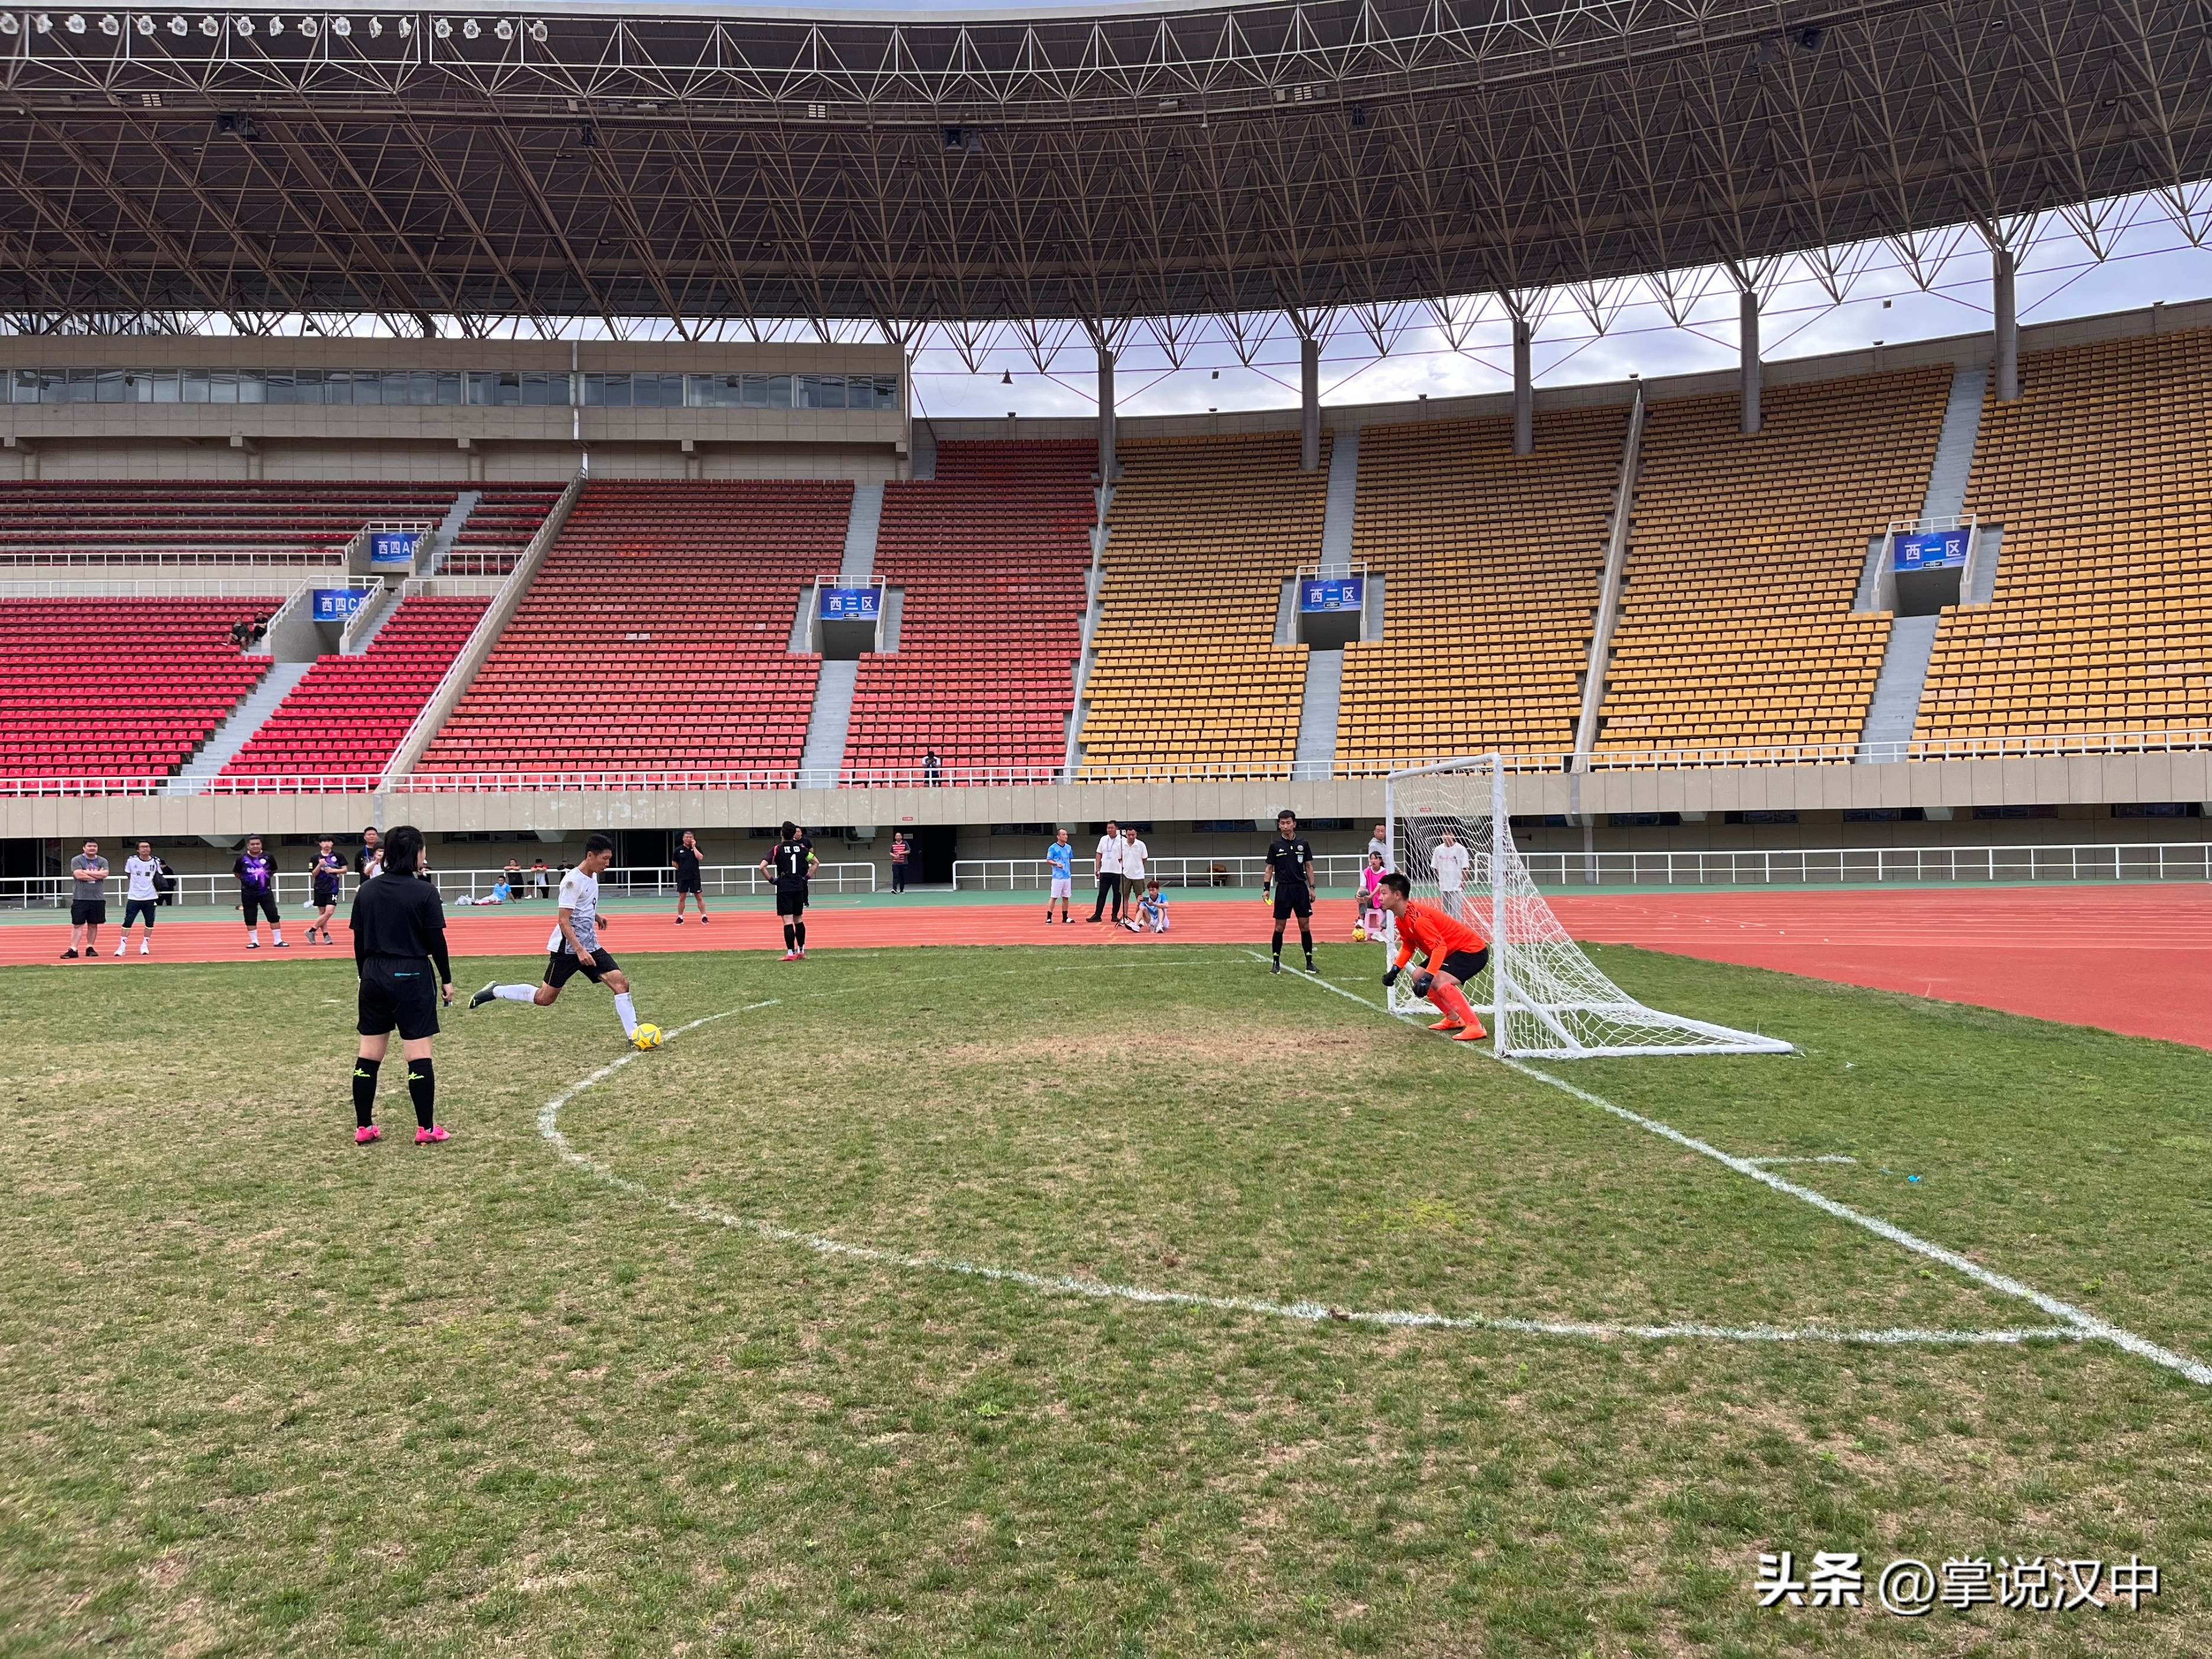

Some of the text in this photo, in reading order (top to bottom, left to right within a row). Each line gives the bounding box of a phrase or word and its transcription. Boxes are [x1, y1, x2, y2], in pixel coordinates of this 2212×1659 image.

[377, 541, 417, 554] 西四A
[1904, 540, 1961, 561] 西一区
[1310, 587, 1355, 603] 西二区
[829, 596, 874, 611] 西三区
[790, 854, 796, 874] 1
